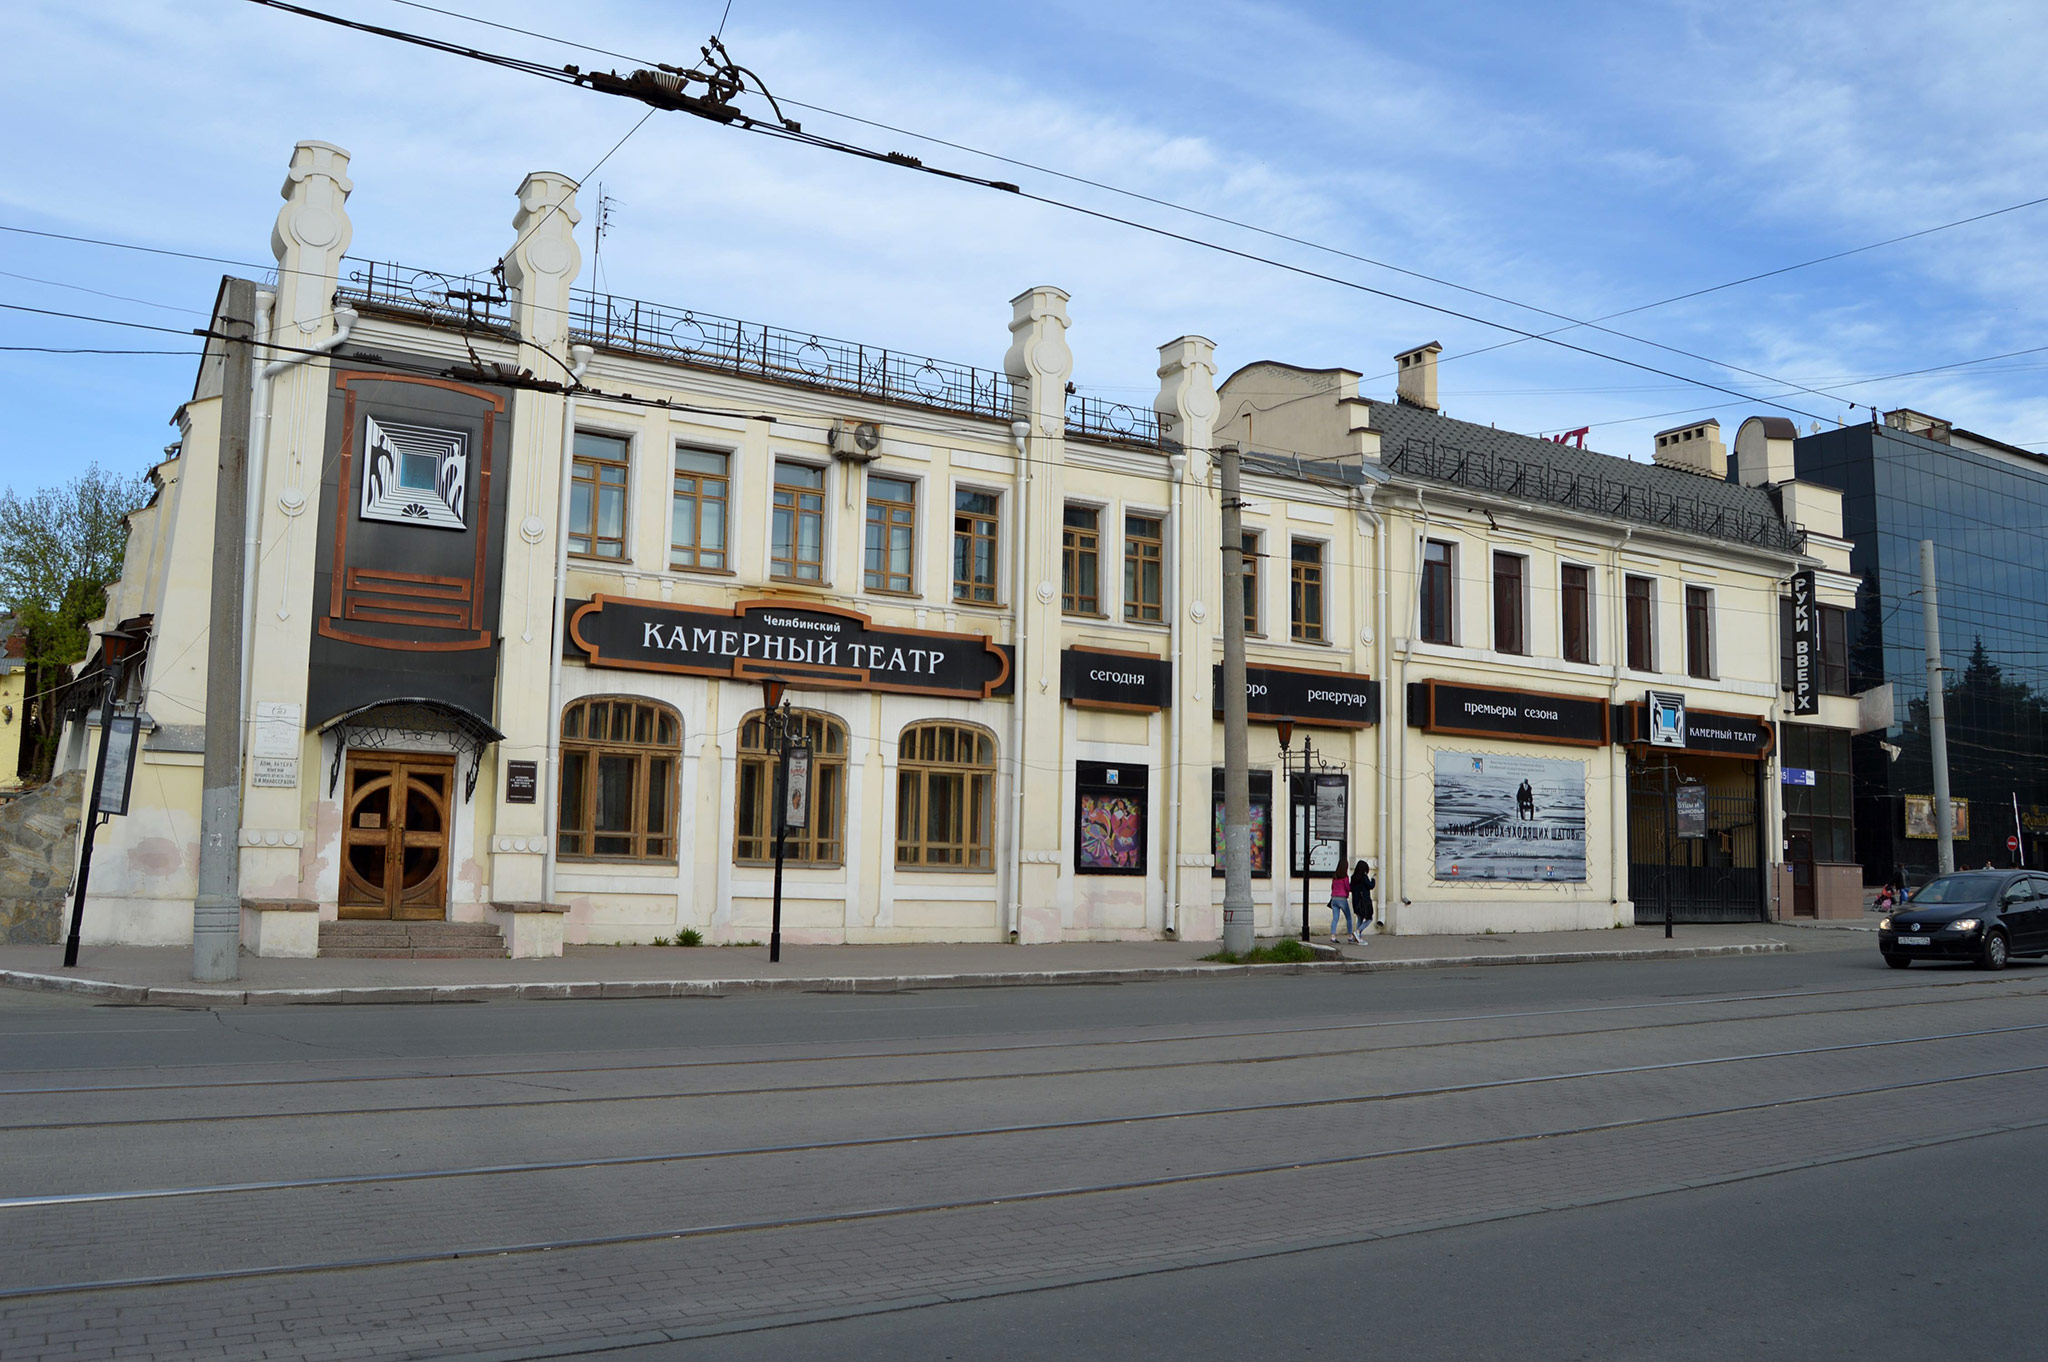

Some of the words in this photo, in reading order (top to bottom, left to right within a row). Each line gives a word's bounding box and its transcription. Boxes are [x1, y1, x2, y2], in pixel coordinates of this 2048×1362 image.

[1794, 578, 1809, 633] РУКИ
[763, 614, 841, 633] Челябинский
[642, 622, 838, 666] КАМЕРНЫЙ
[847, 643, 945, 675] ТЕАТР
[1090, 669, 1145, 686] сегодня
[1796, 640, 1811, 709] ВВЕРХ
[1308, 689, 1367, 707] репертуар
[1464, 702, 1517, 718] премьеры
[1524, 708, 1558, 720] сезона
[1689, 727, 1732, 740] КАМЕРНЫЙ
[1734, 732, 1757, 742] ТЕАТР
[1478, 825, 1505, 837] ШОРОХ
[1507, 826, 1549, 841] УХОДЯЩИХ
